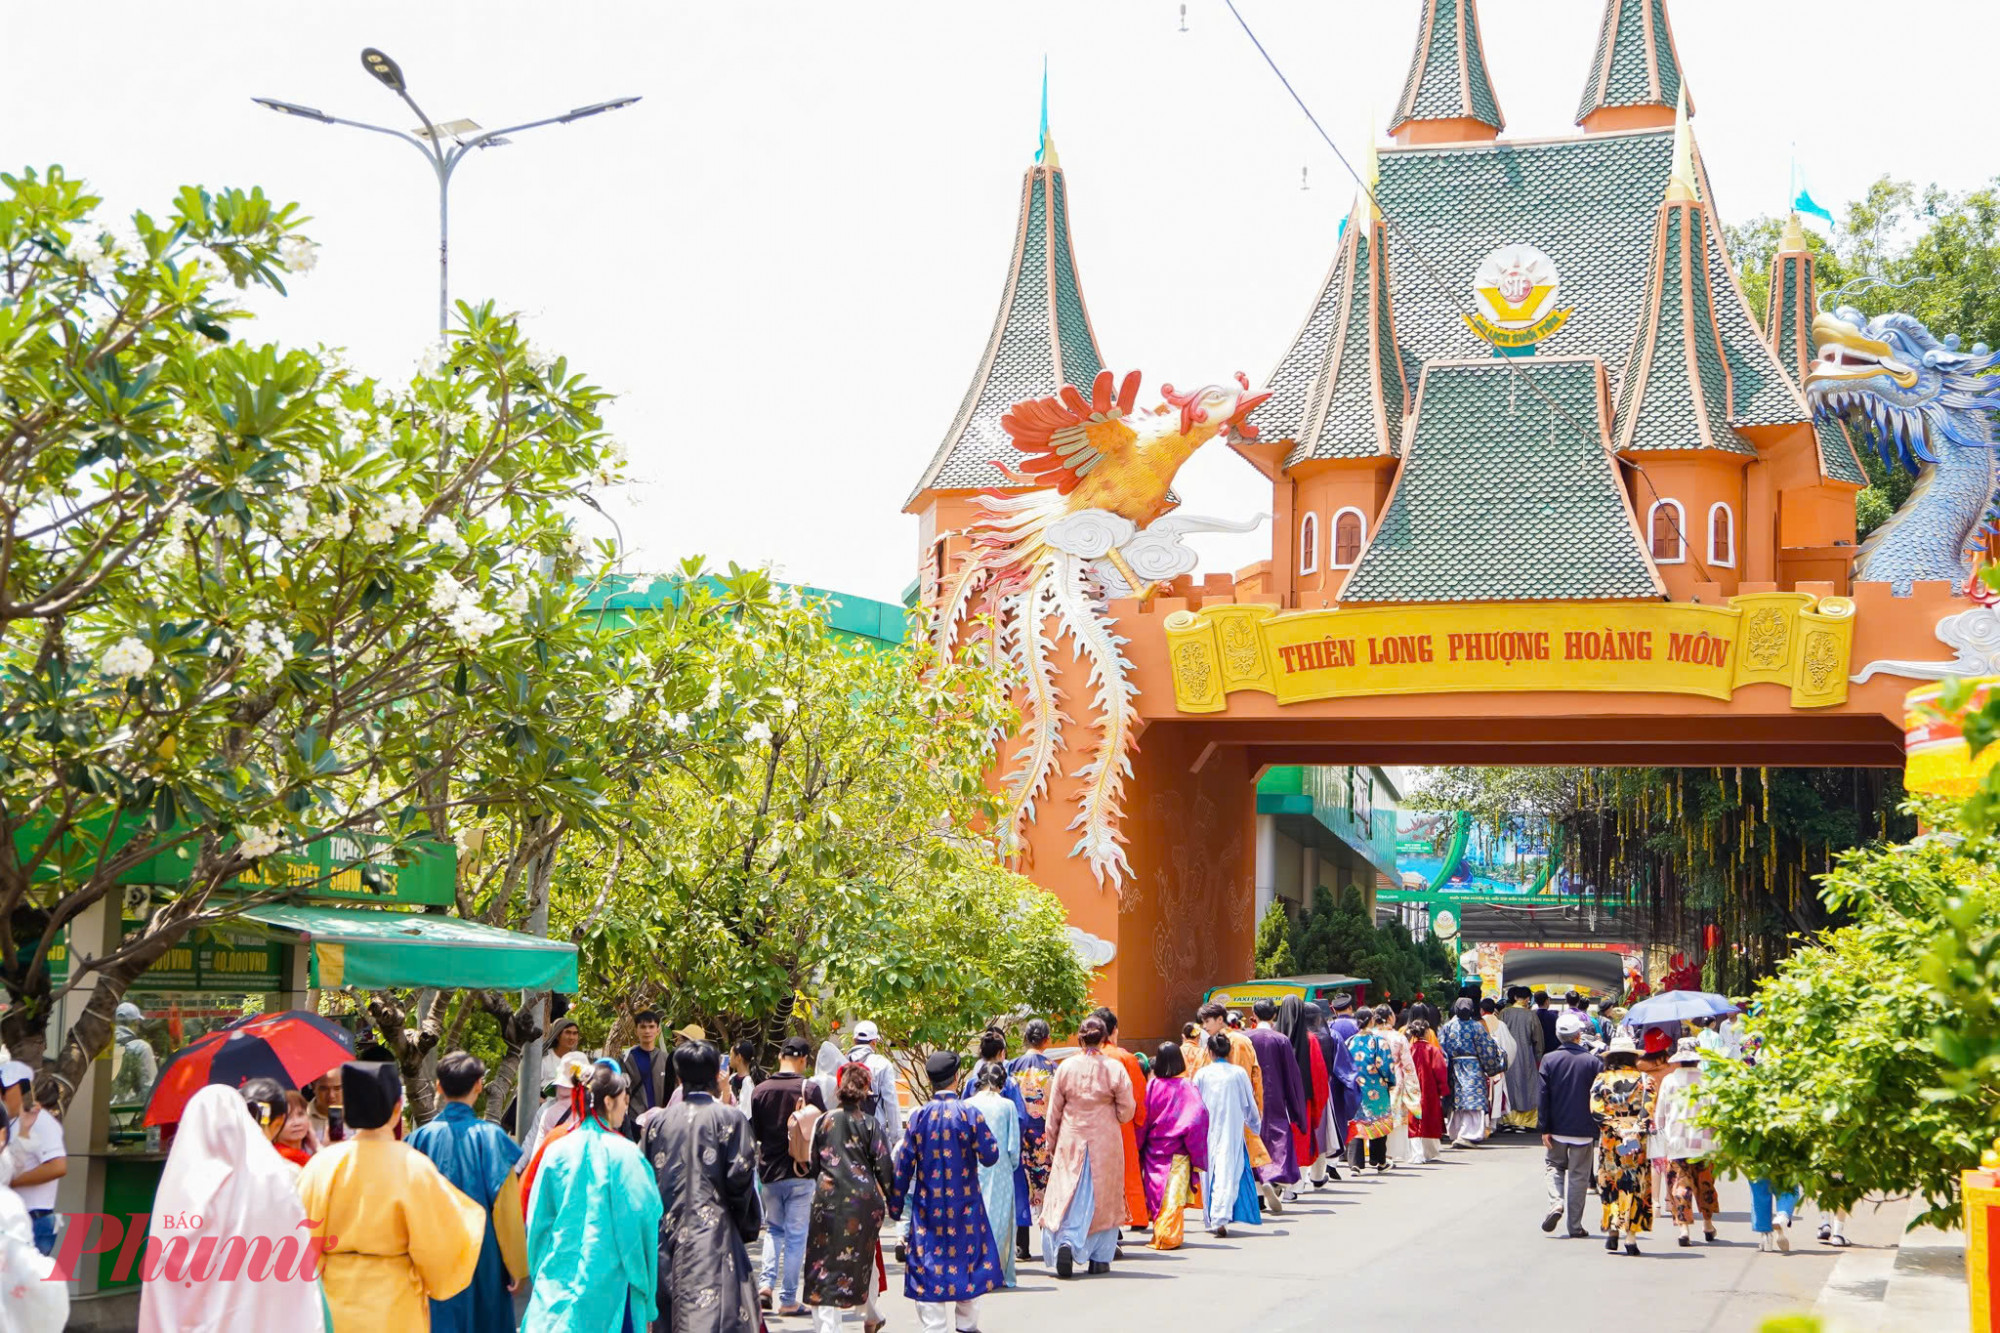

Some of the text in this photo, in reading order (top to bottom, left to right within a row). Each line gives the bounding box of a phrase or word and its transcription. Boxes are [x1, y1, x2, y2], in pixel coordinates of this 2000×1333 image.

[1278, 628, 1731, 674] THIÊN LONG PHƯỢNG HOÀNG MÔN
